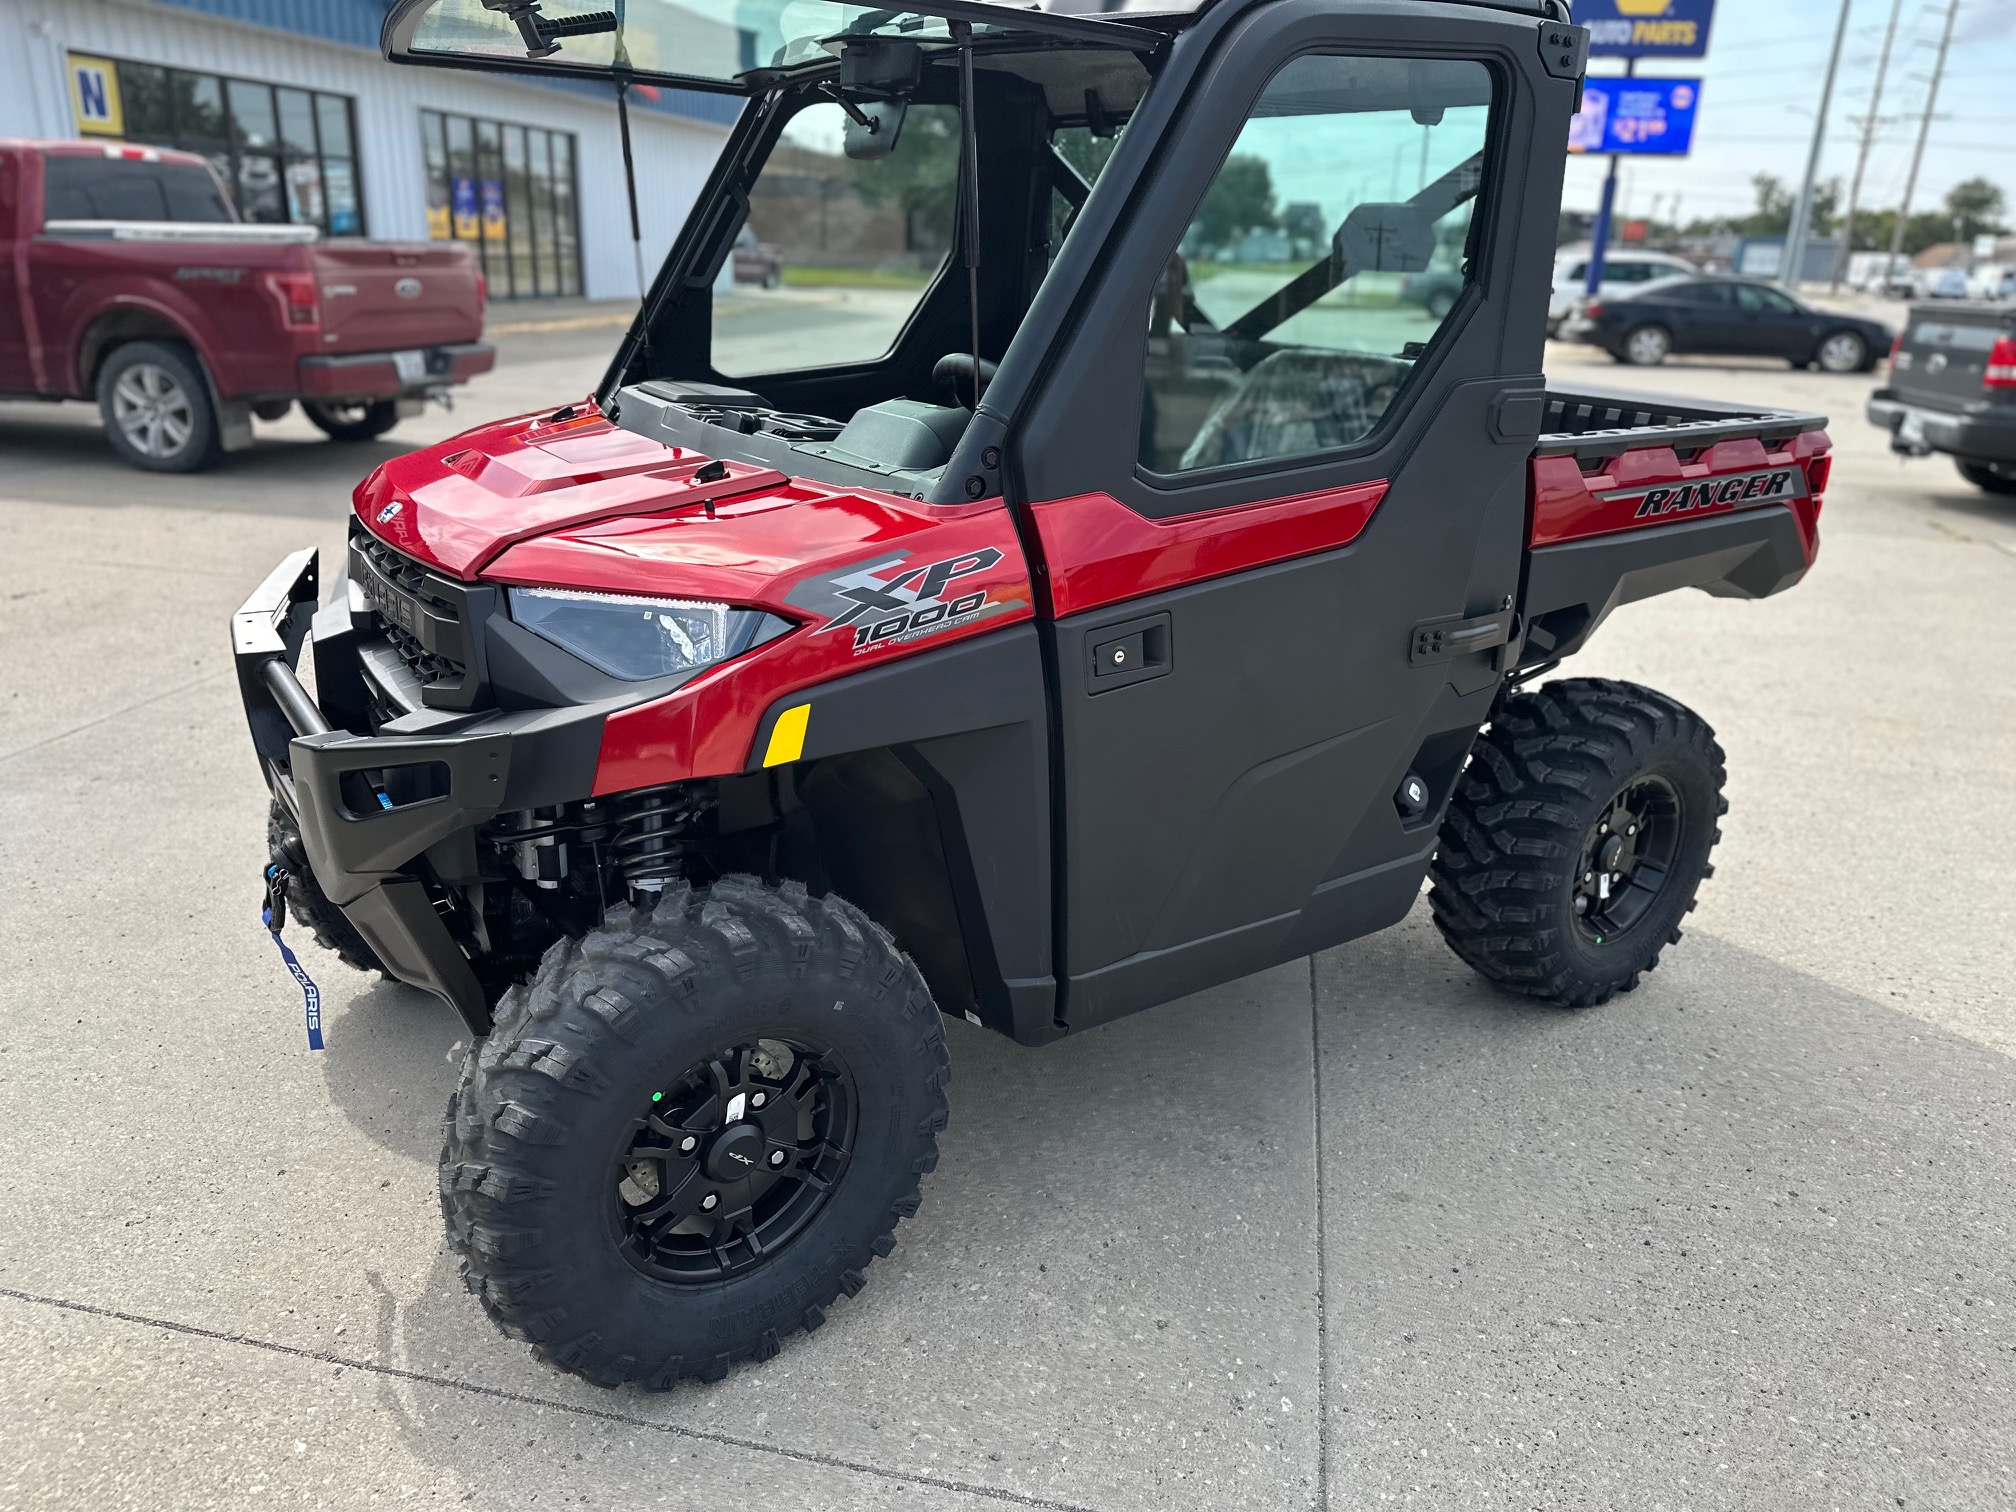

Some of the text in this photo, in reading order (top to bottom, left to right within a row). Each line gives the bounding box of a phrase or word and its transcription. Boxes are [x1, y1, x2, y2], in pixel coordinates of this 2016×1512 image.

[1632, 21, 1697, 46] PARTS
[79, 71, 106, 116] N
[1634, 470, 1792, 518] RANGER
[808, 546, 1005, 638] XP
[852, 590, 987, 649] 1000
[853, 612, 980, 657] DUAL OVERHEAD CAM
[288, 962, 319, 1030] POLARIS
